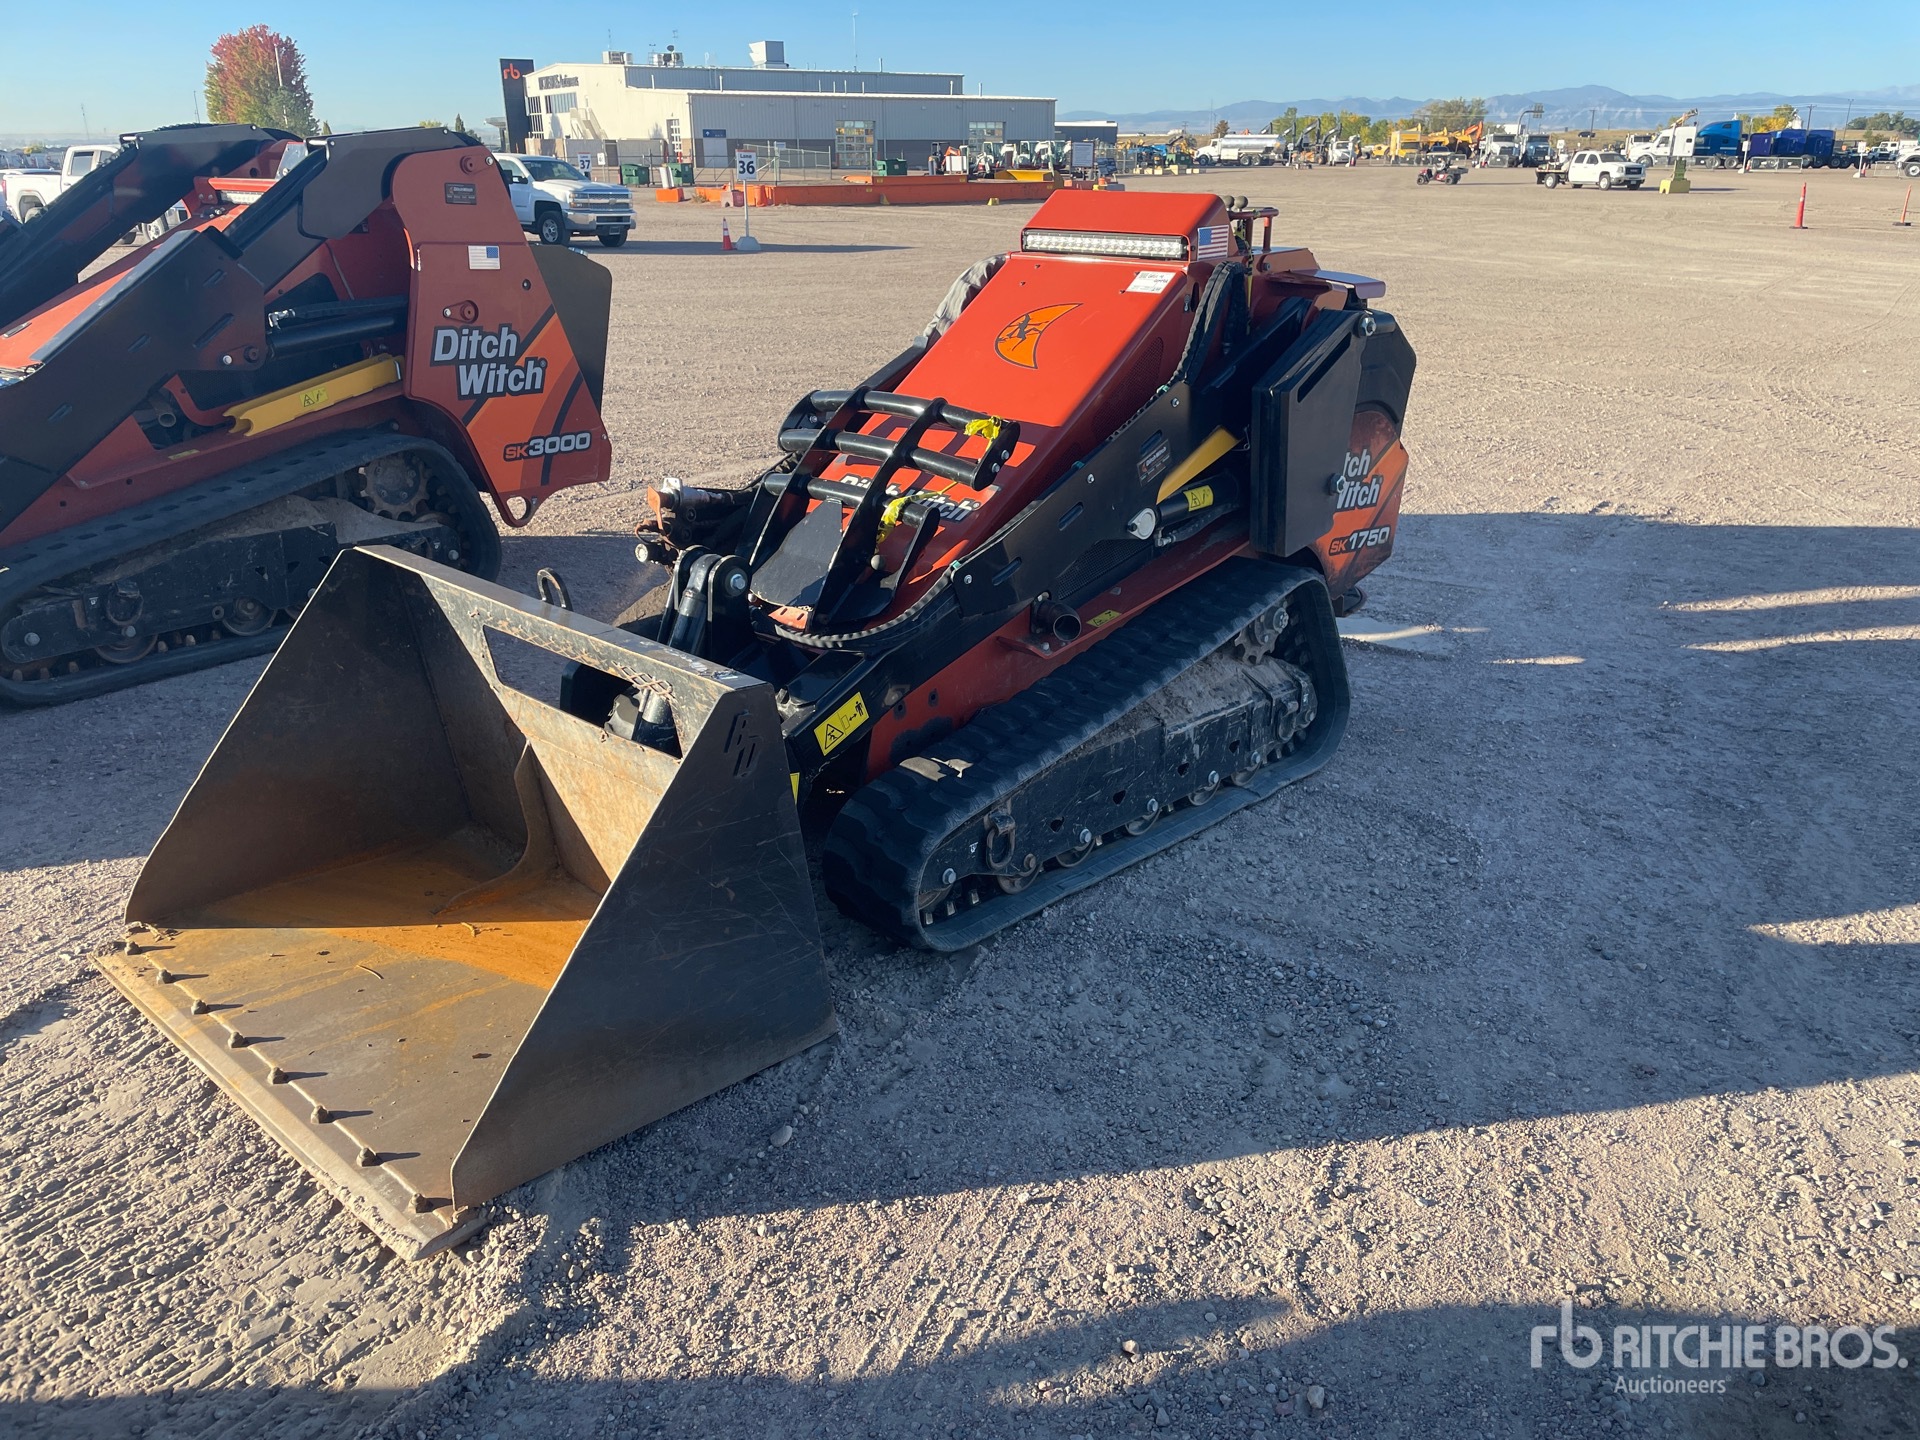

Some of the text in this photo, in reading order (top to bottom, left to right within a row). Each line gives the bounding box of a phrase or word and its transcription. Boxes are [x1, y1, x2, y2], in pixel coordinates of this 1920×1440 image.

[503, 63, 521, 80] rb
[579, 159, 591, 170] 37
[738, 160, 756, 175] 36
[433, 326, 518, 362] Ditch
[458, 360, 543, 396] Witch
[505, 432, 591, 459] SK3000
[1329, 526, 1391, 554] SK1750
